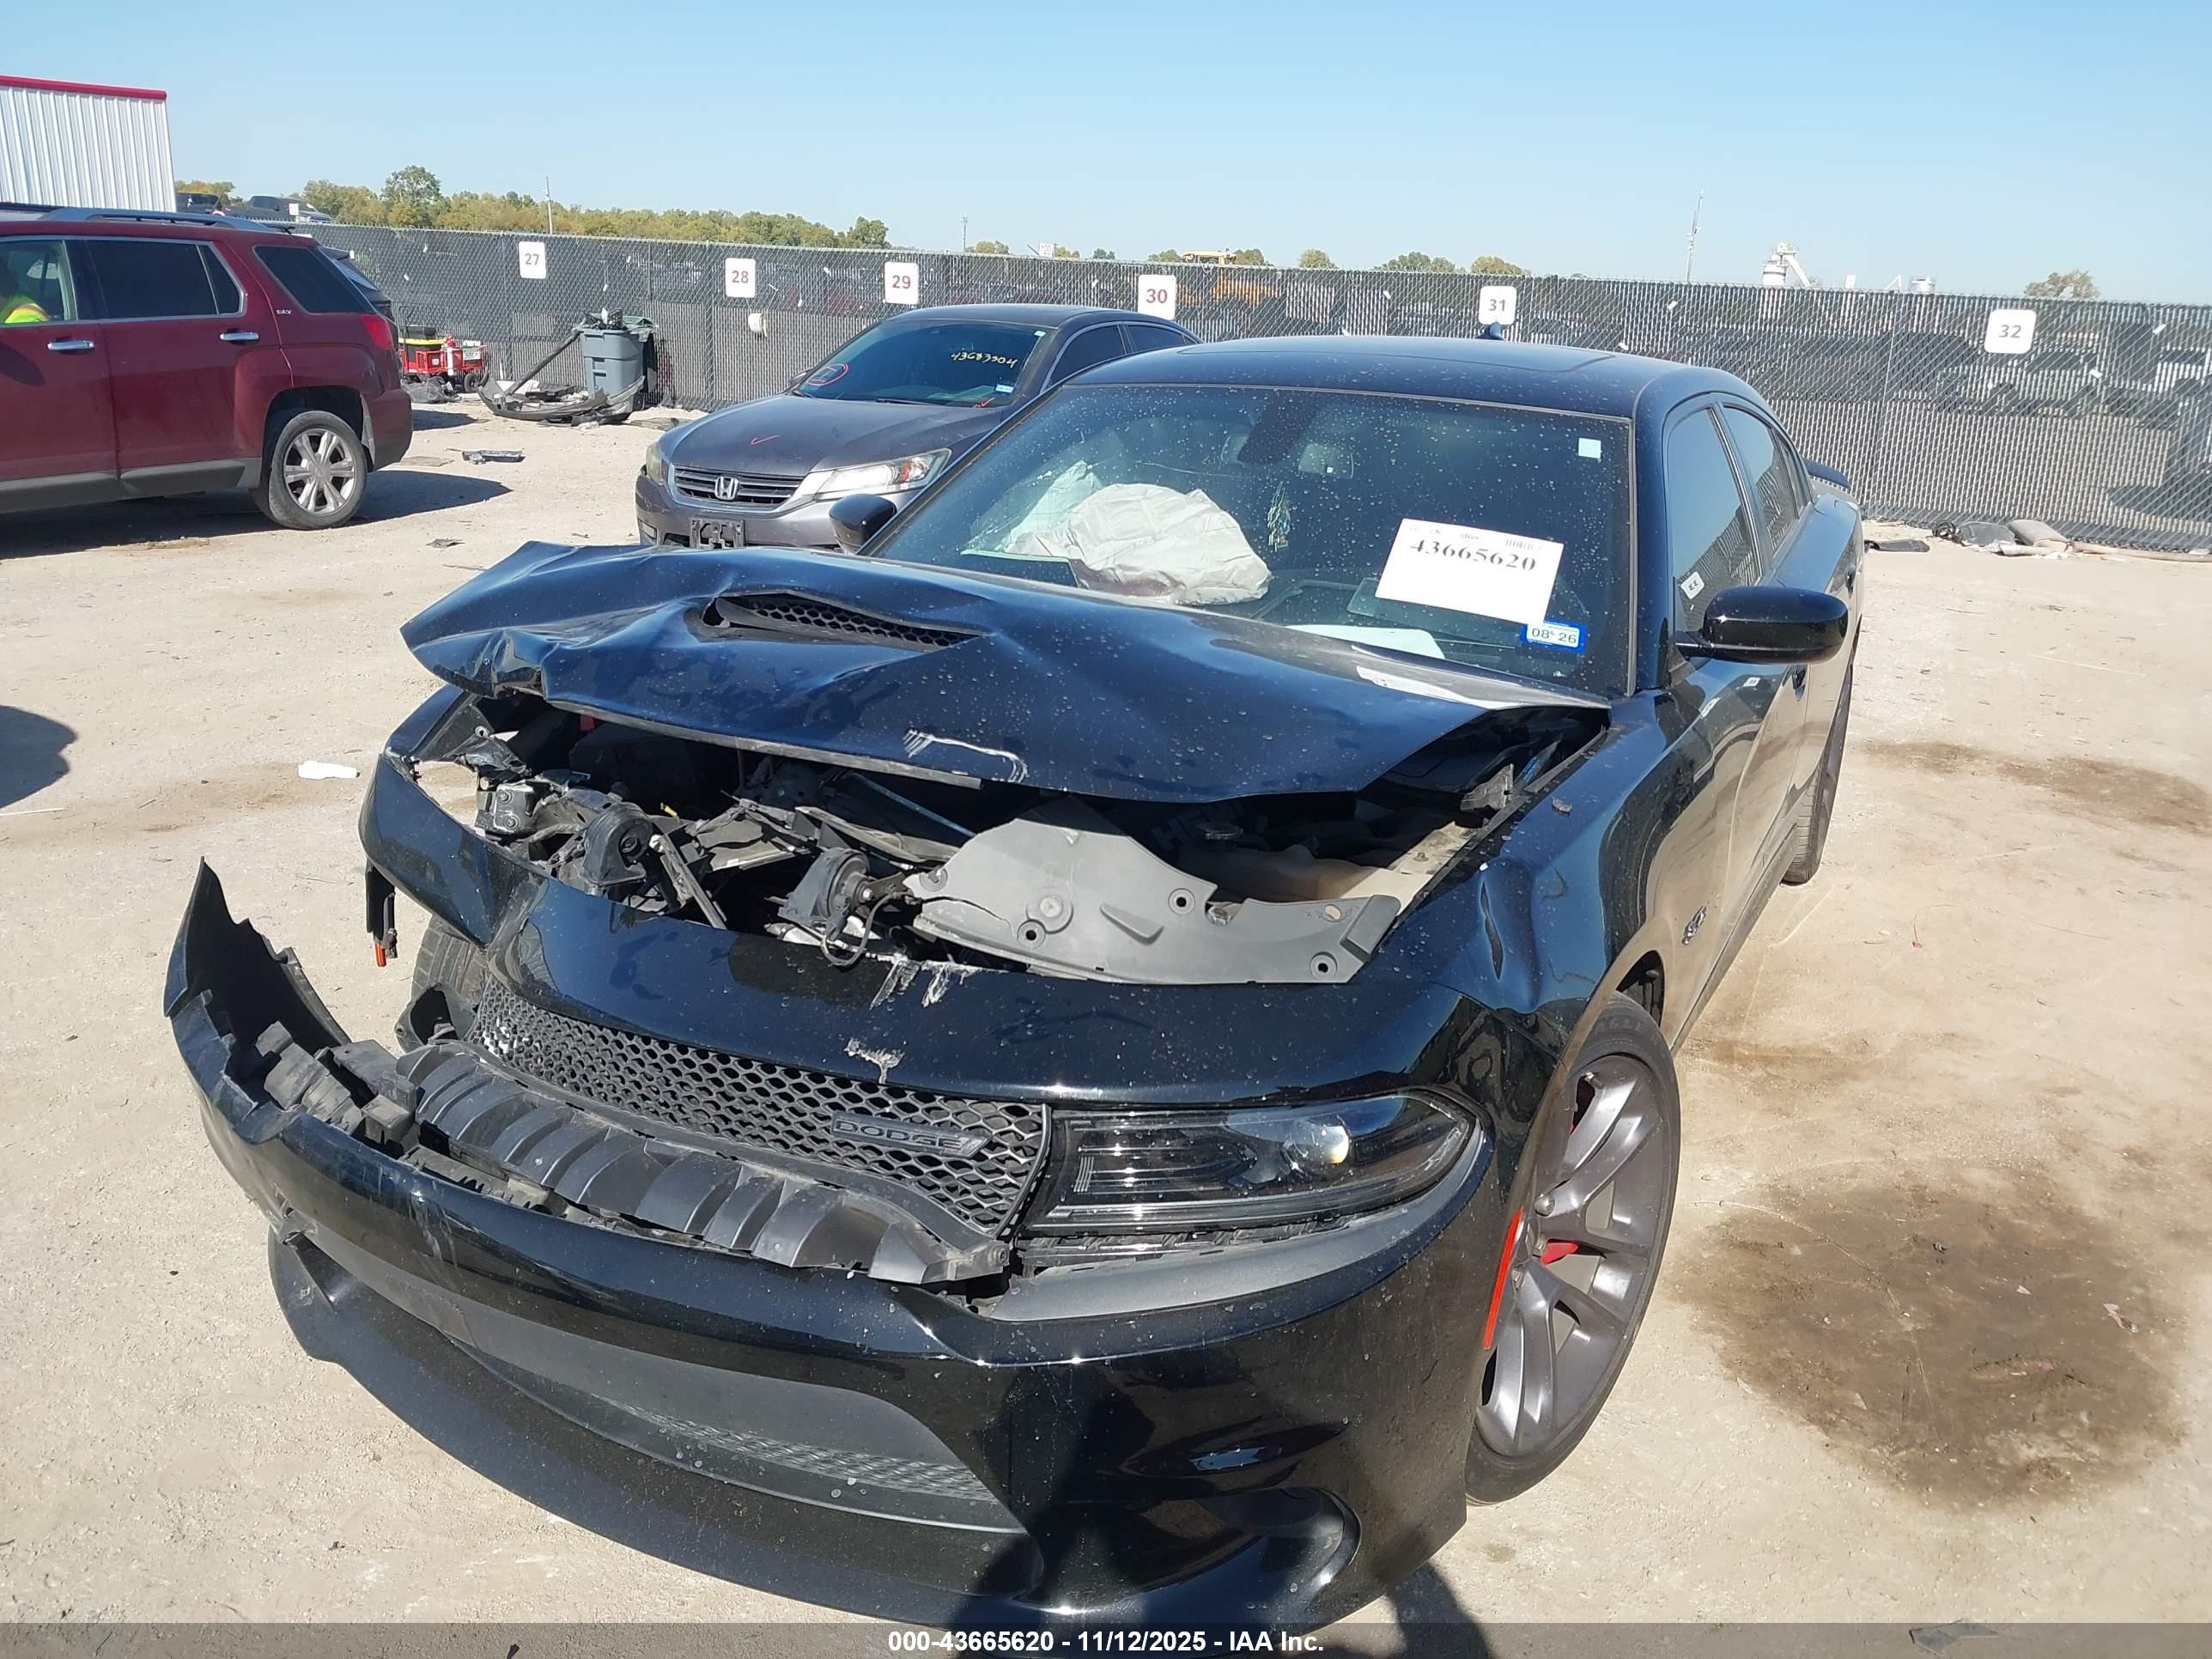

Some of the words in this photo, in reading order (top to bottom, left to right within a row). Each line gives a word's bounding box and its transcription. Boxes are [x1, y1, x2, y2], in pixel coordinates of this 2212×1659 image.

[525, 252, 539, 265] 27
[732, 270, 749, 283] 28
[892, 275, 911, 289] 29
[1146, 289, 1168, 304] 30
[1489, 299, 1505, 312] 31
[1998, 325, 2021, 338] 32
[1410, 539, 1536, 571] 43665620
[1531, 628, 1549, 639] 08
[1559, 633, 1577, 643] 26
[836, 1119, 963, 1149] DODGE
